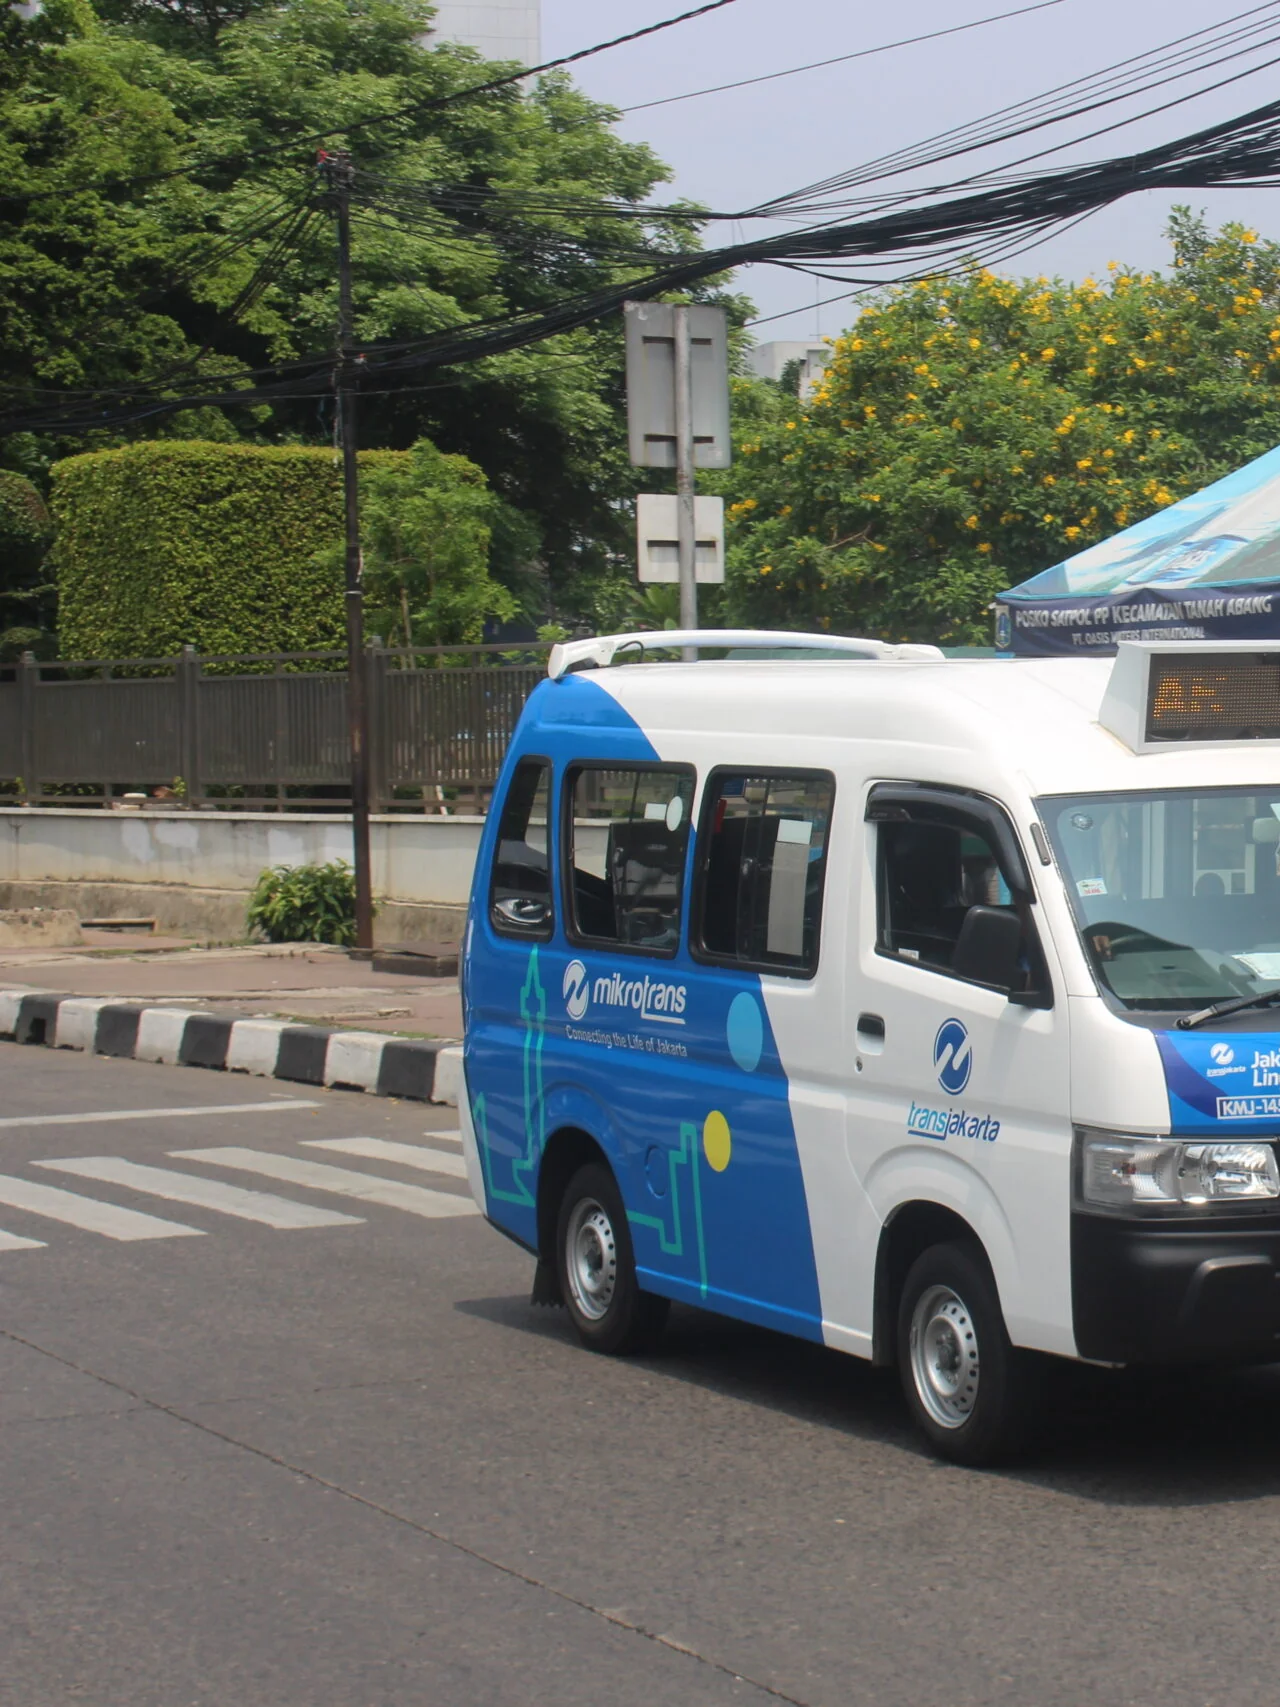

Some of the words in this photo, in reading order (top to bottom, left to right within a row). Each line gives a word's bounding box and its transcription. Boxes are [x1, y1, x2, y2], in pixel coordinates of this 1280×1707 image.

[1015, 609, 1049, 628] POSKO
[1050, 608, 1092, 628] SATPOL
[1094, 606, 1109, 625] PP
[1112, 602, 1184, 624] KECAMATAN
[1187, 597, 1225, 619] TANAH
[1226, 594, 1272, 615] ABANG
[1085, 631, 1109, 645] OASIS
[1142, 626, 1205, 641] INTERNATIONAL
[593, 972, 687, 1025] mikrotrans
[565, 1024, 613, 1049] Connecting
[613, 1033, 627, 1048] the
[628, 1033, 643, 1050] Life
[645, 1037, 654, 1052] of
[656, 1038, 688, 1058] Jakarta
[1251, 1050, 1280, 1069] Jak
[907, 1100, 1001, 1141] transjakarta
